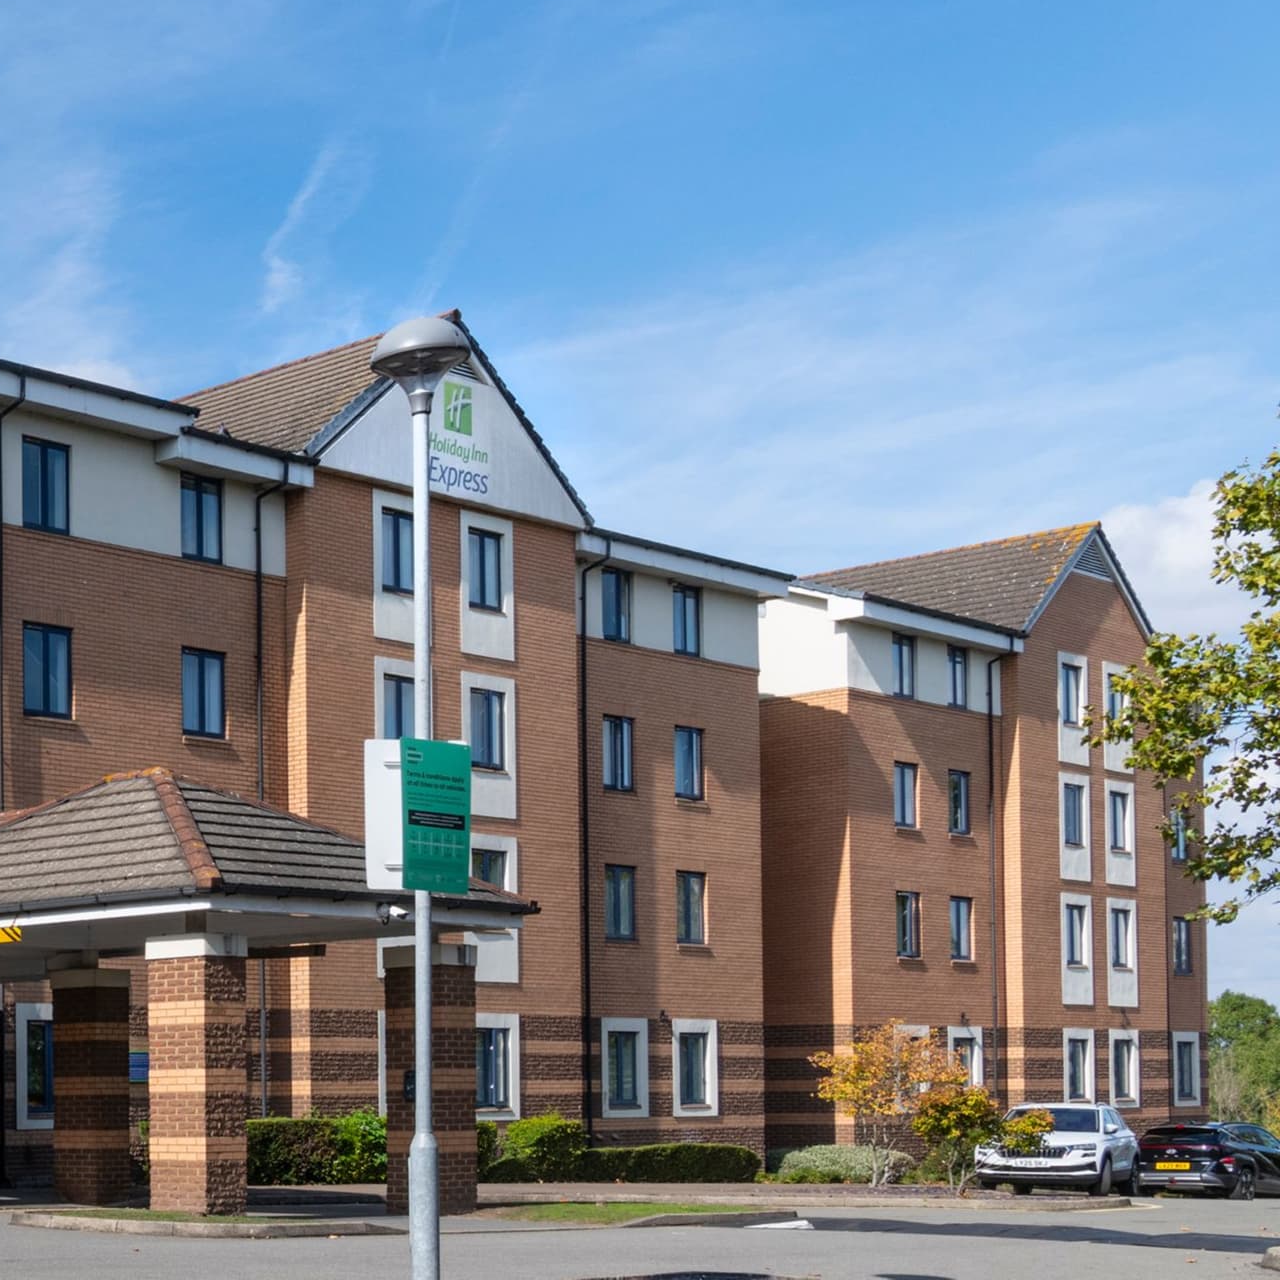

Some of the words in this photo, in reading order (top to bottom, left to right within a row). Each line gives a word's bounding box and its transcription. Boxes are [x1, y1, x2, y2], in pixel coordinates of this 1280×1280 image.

[429, 431, 470, 464] Holiday
[472, 443, 488, 464] Inn
[428, 455, 489, 494] Express
